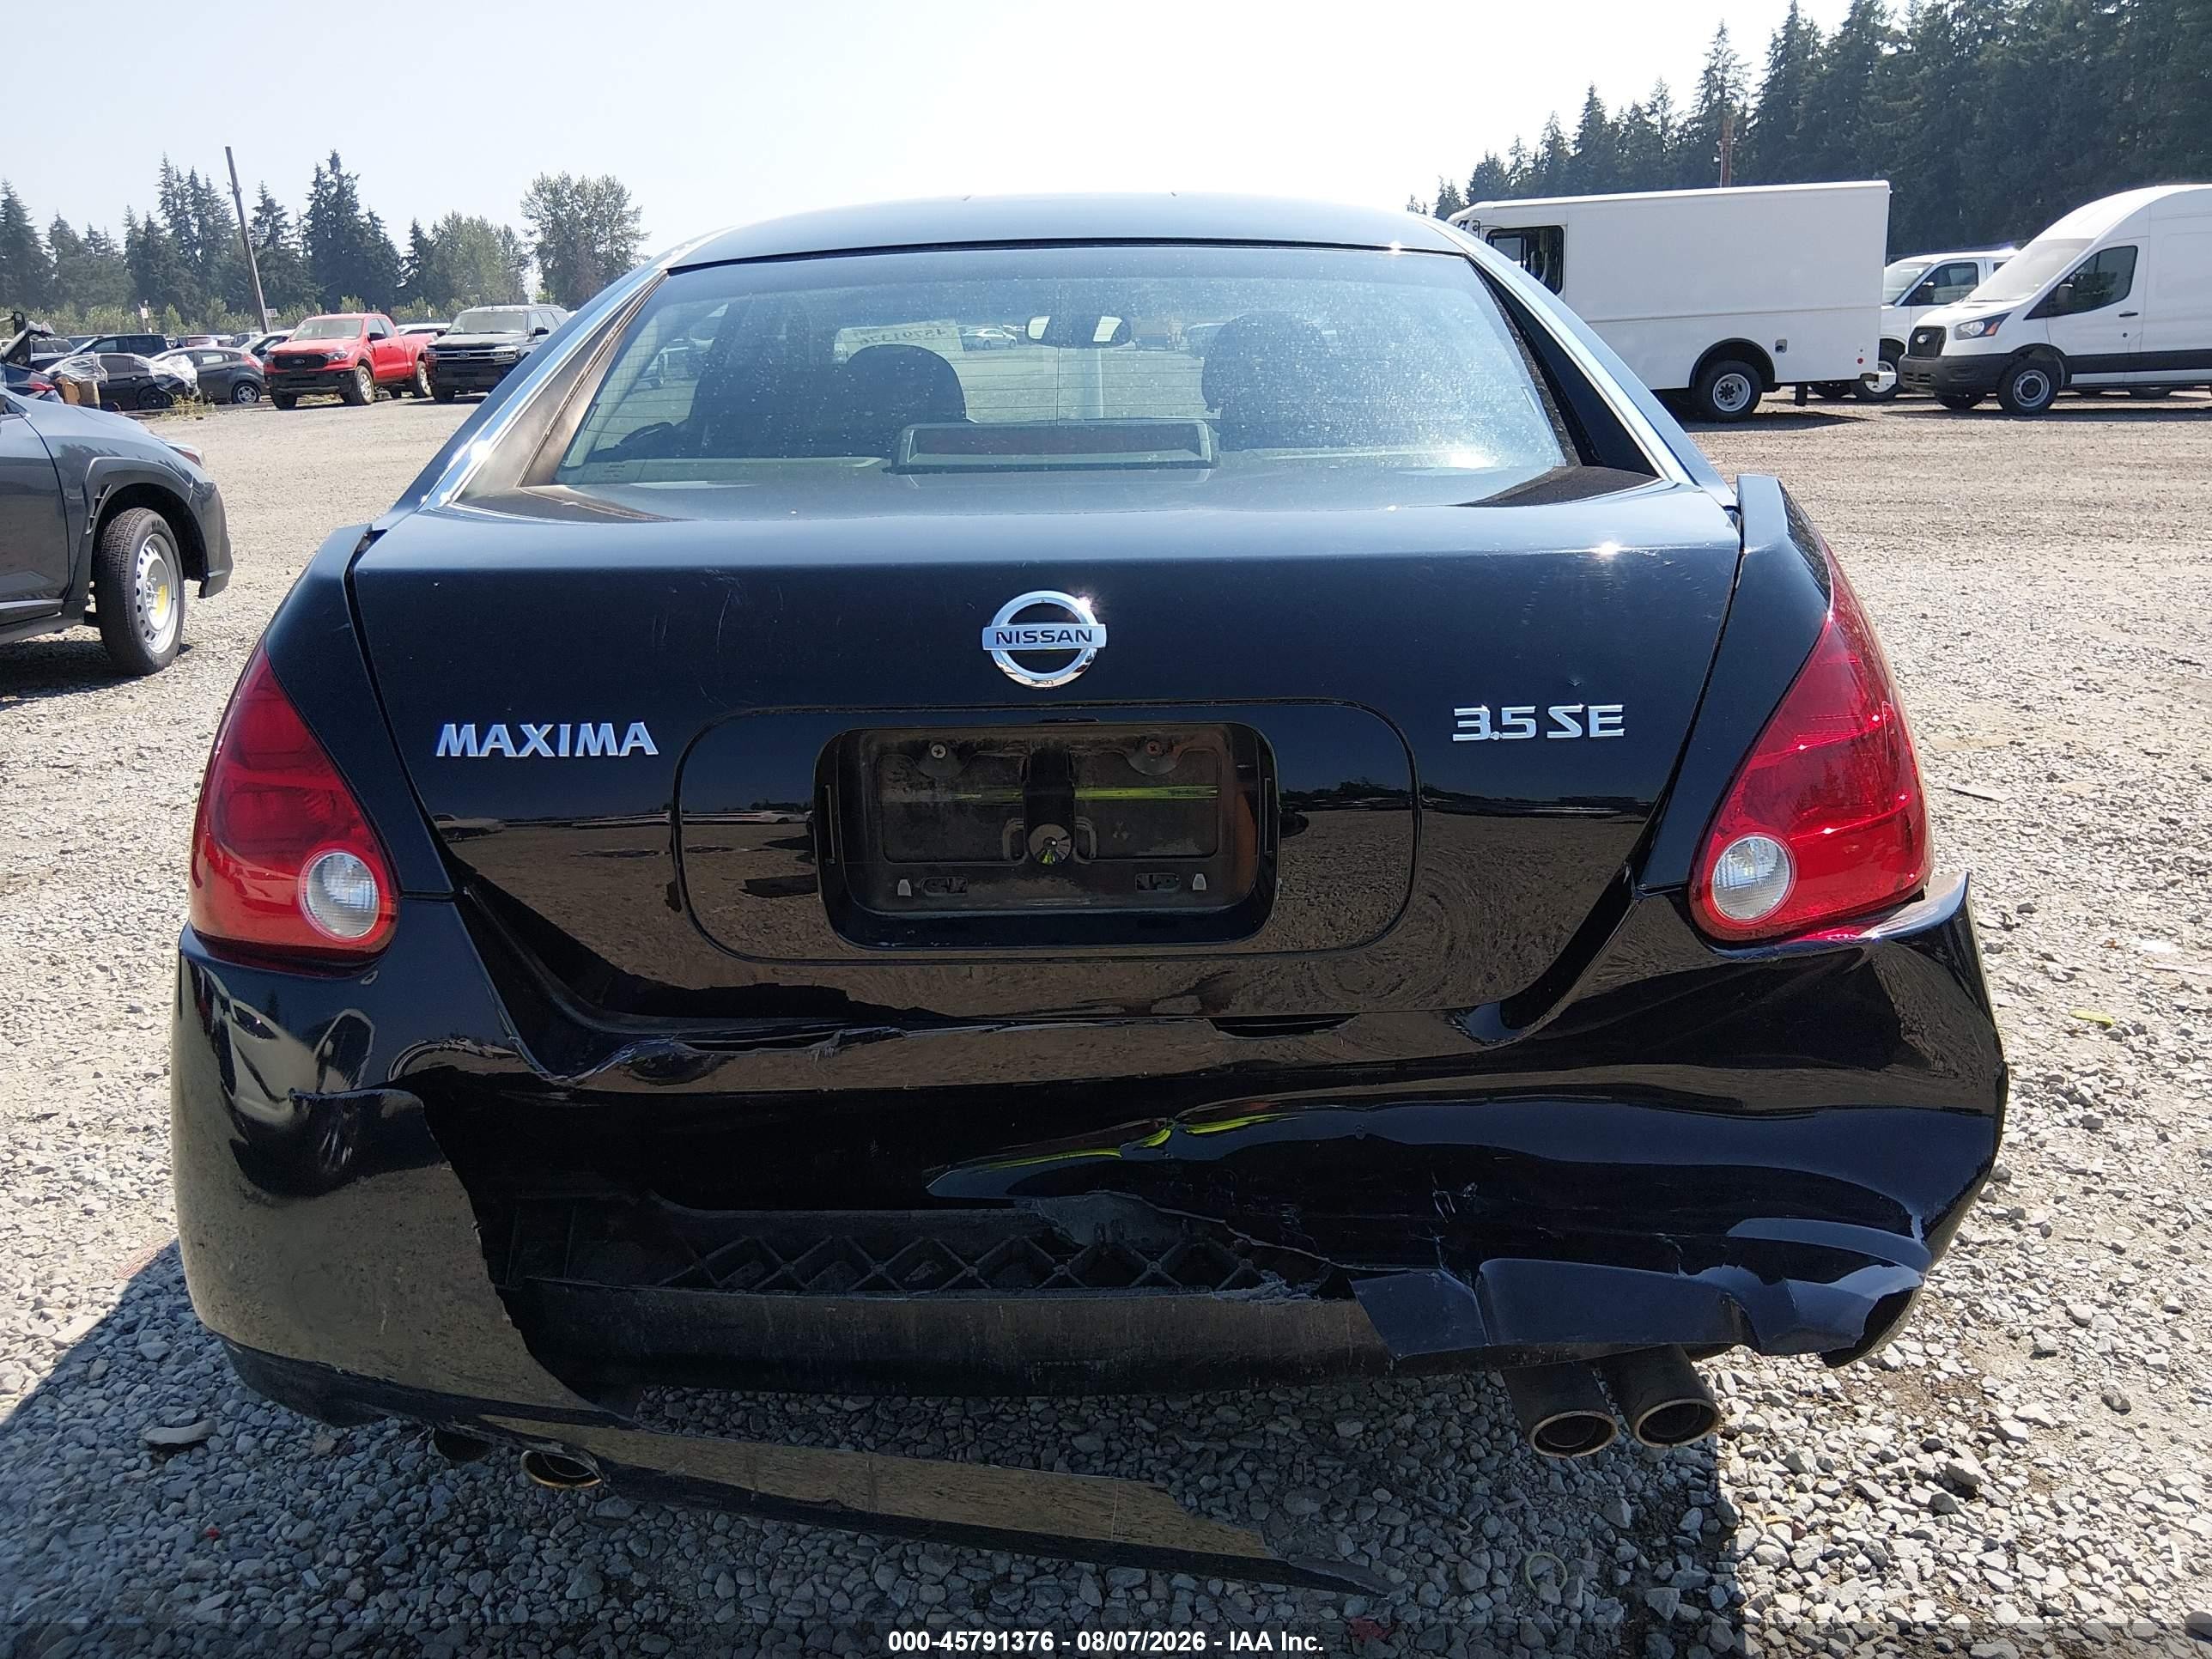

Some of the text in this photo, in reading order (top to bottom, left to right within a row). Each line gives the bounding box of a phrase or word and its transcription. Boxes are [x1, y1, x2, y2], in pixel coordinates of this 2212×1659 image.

[995, 629, 1093, 645] NISSAN
[436, 721, 659, 757] MAXIMA
[1452, 703, 1626, 742] 3.5 SE
